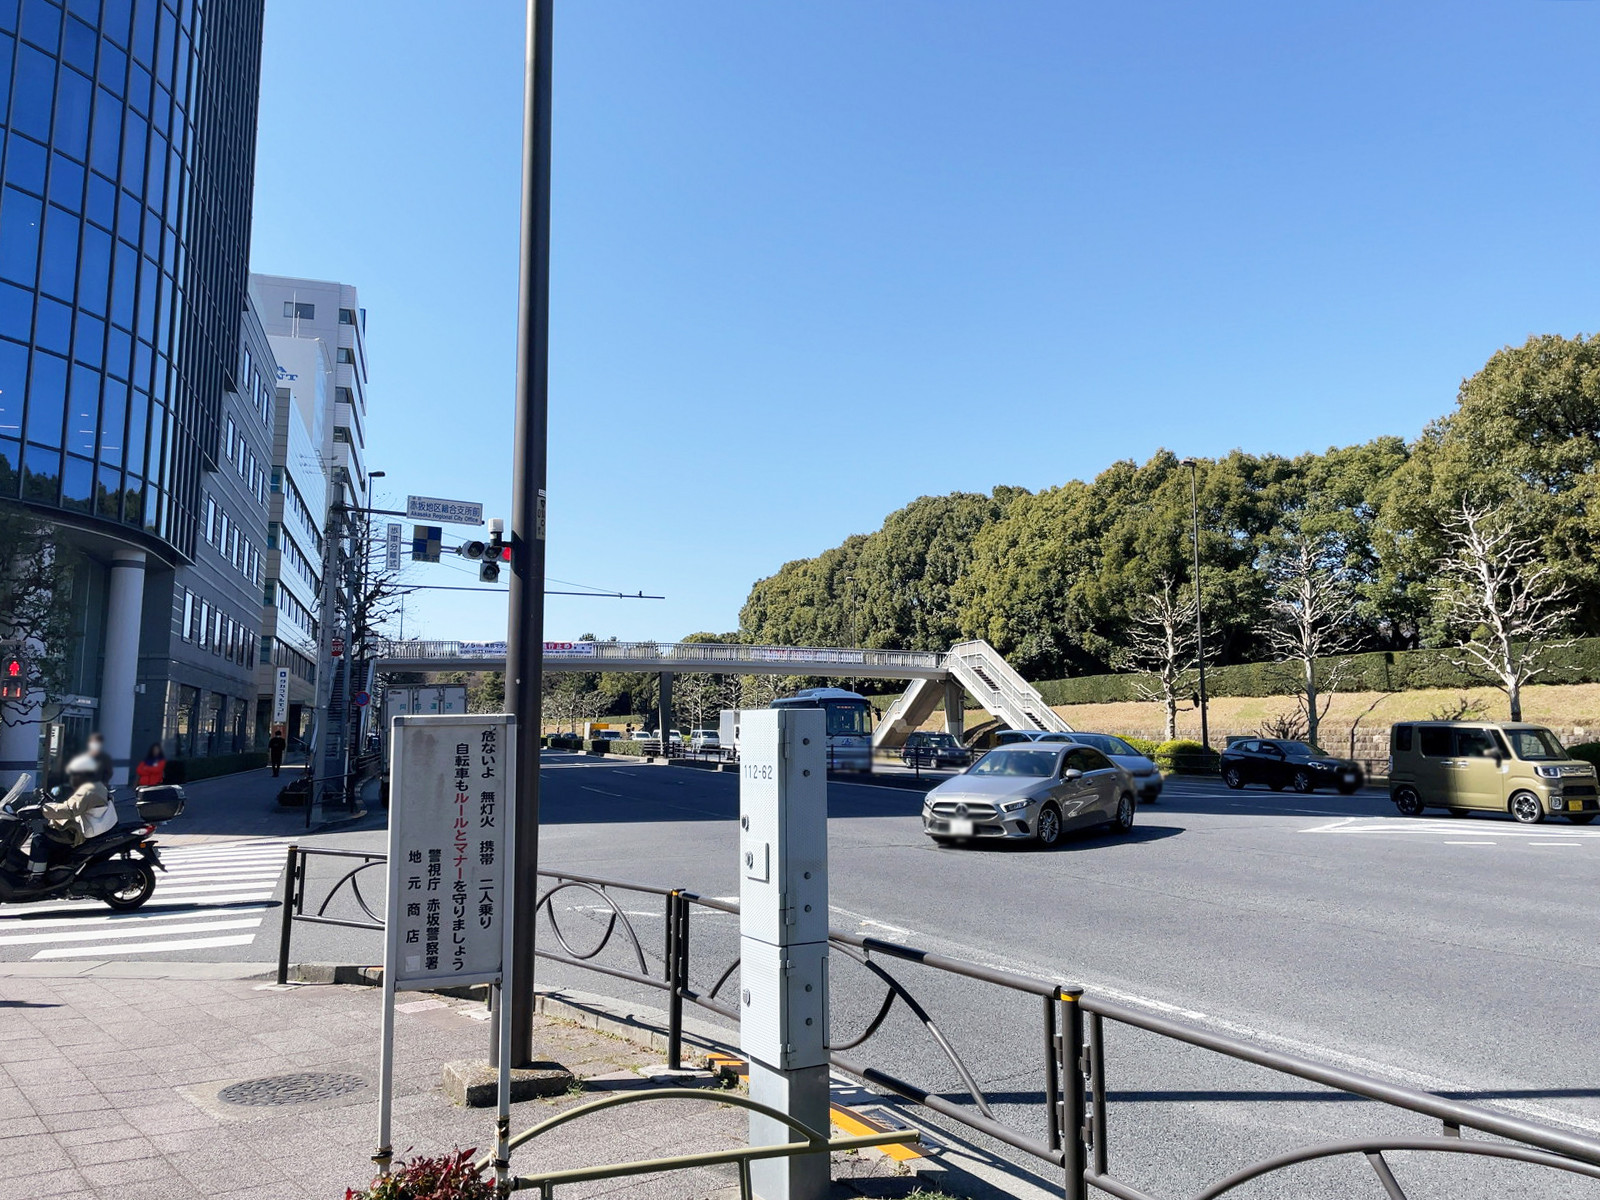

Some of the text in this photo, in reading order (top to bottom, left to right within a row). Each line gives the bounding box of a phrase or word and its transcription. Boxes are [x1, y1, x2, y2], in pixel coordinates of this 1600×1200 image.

[744, 764, 773, 780] 112-62
[478, 730, 497, 930] 危ないよ 無灯火 携帯 二人乗り
[406, 850, 422, 944] 地元商店
[425, 849, 442, 970] 警視庁 赤坂警察署
